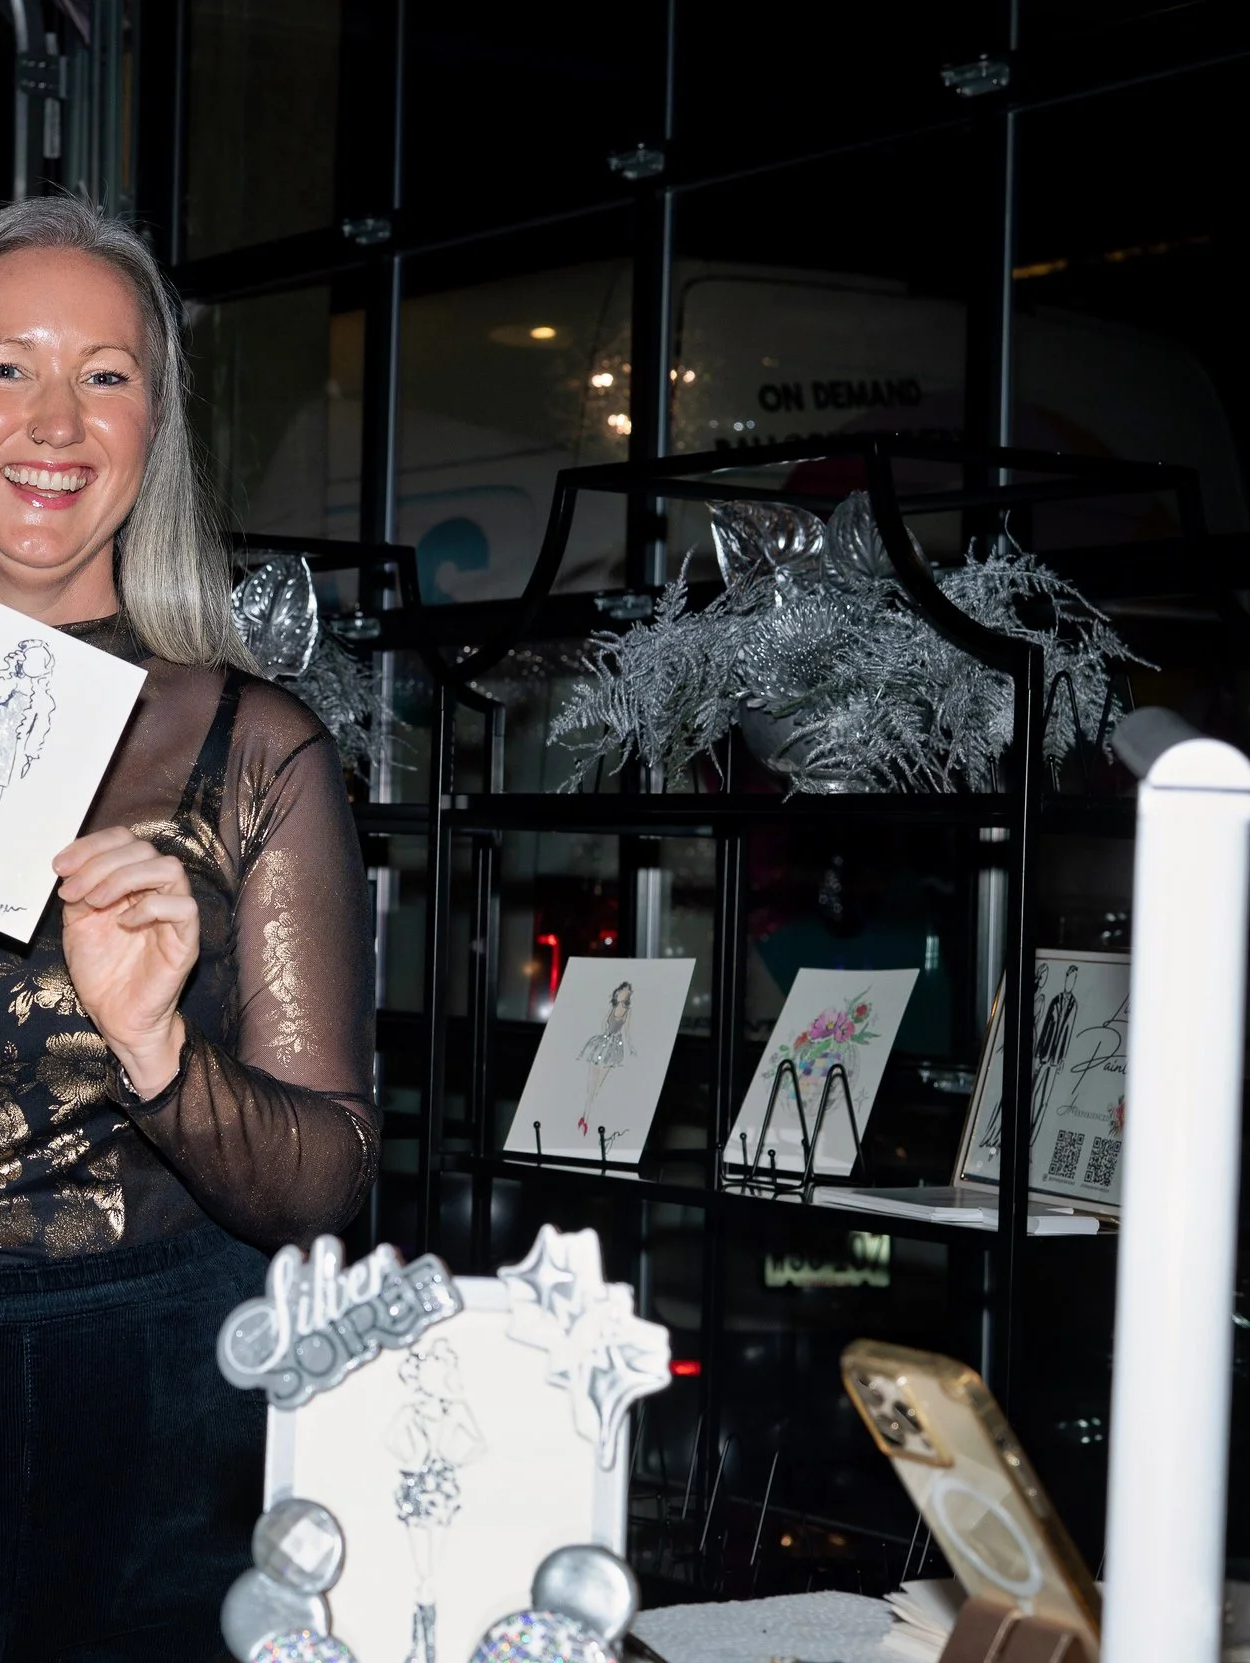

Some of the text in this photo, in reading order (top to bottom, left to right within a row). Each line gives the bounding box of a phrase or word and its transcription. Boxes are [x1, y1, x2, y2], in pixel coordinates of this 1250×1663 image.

[759, 379, 921, 411] ON DEMAND
[224, 1236, 395, 1376] Silver
